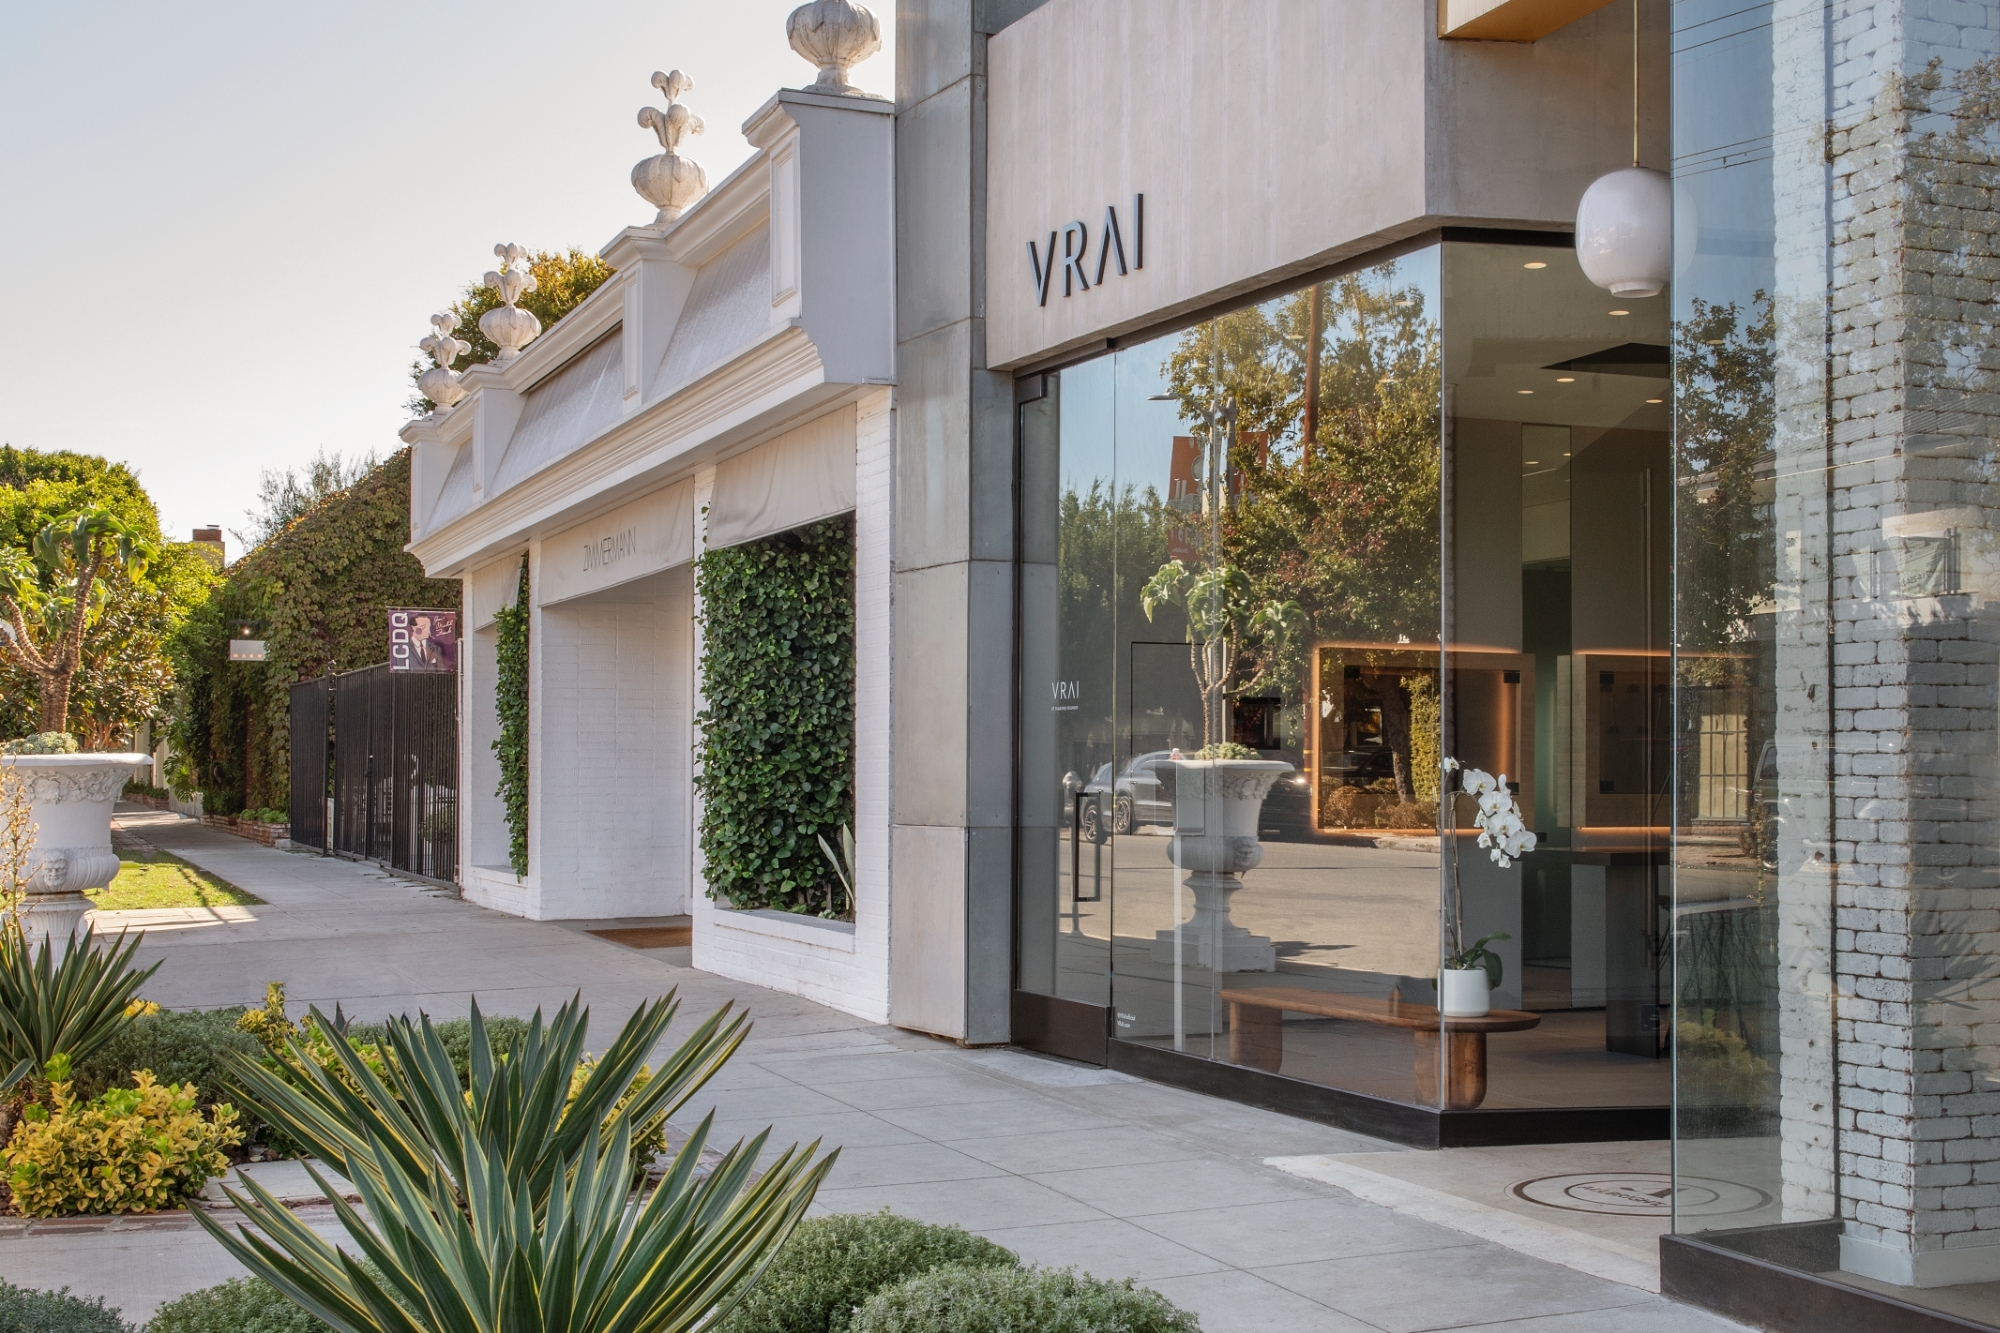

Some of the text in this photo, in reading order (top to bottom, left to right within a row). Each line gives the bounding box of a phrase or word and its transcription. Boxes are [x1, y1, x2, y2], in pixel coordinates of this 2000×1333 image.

[1026, 193, 1144, 307] VRAI
[583, 526, 636, 572] ZIMMERMANN
[391, 612, 410, 670] LCDQ
[1051, 680, 1079, 700] VRAI
